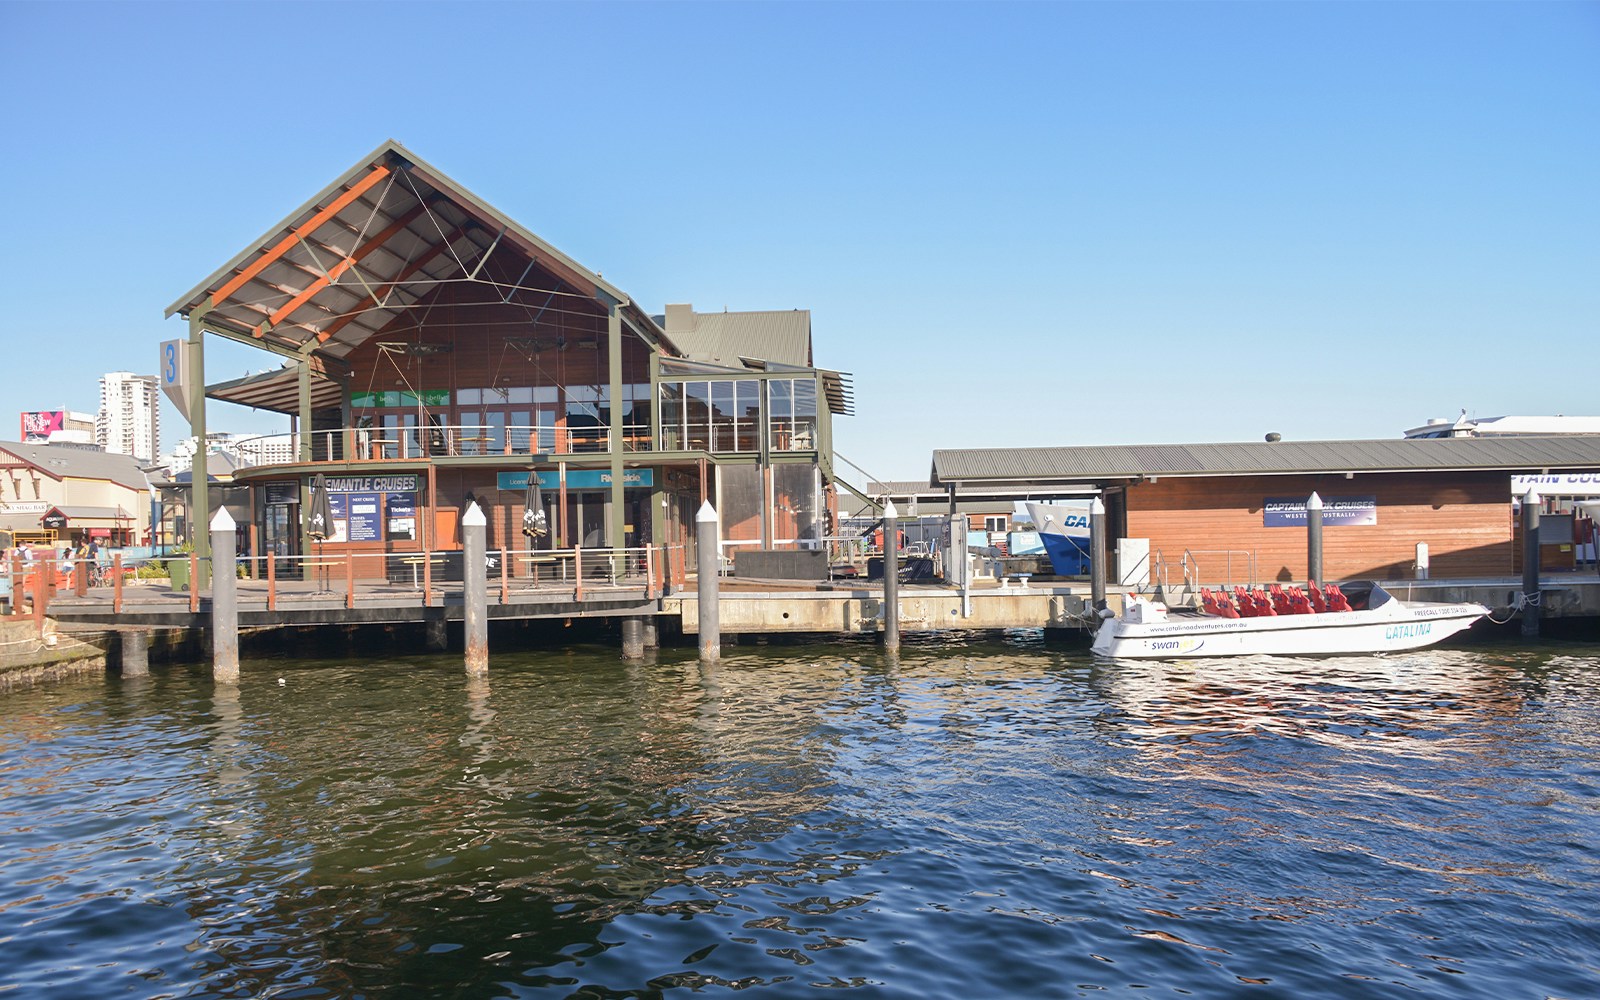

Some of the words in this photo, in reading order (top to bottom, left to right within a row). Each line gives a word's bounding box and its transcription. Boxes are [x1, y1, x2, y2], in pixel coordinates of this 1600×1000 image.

[165, 344, 176, 383] 3
[373, 477, 416, 491] CRUISES
[1265, 502, 1306, 511] CAPTAIN
[1335, 501, 1375, 510] CRUISES
[1064, 515, 1091, 529] CA
[1385, 623, 1432, 640] CATALINA
